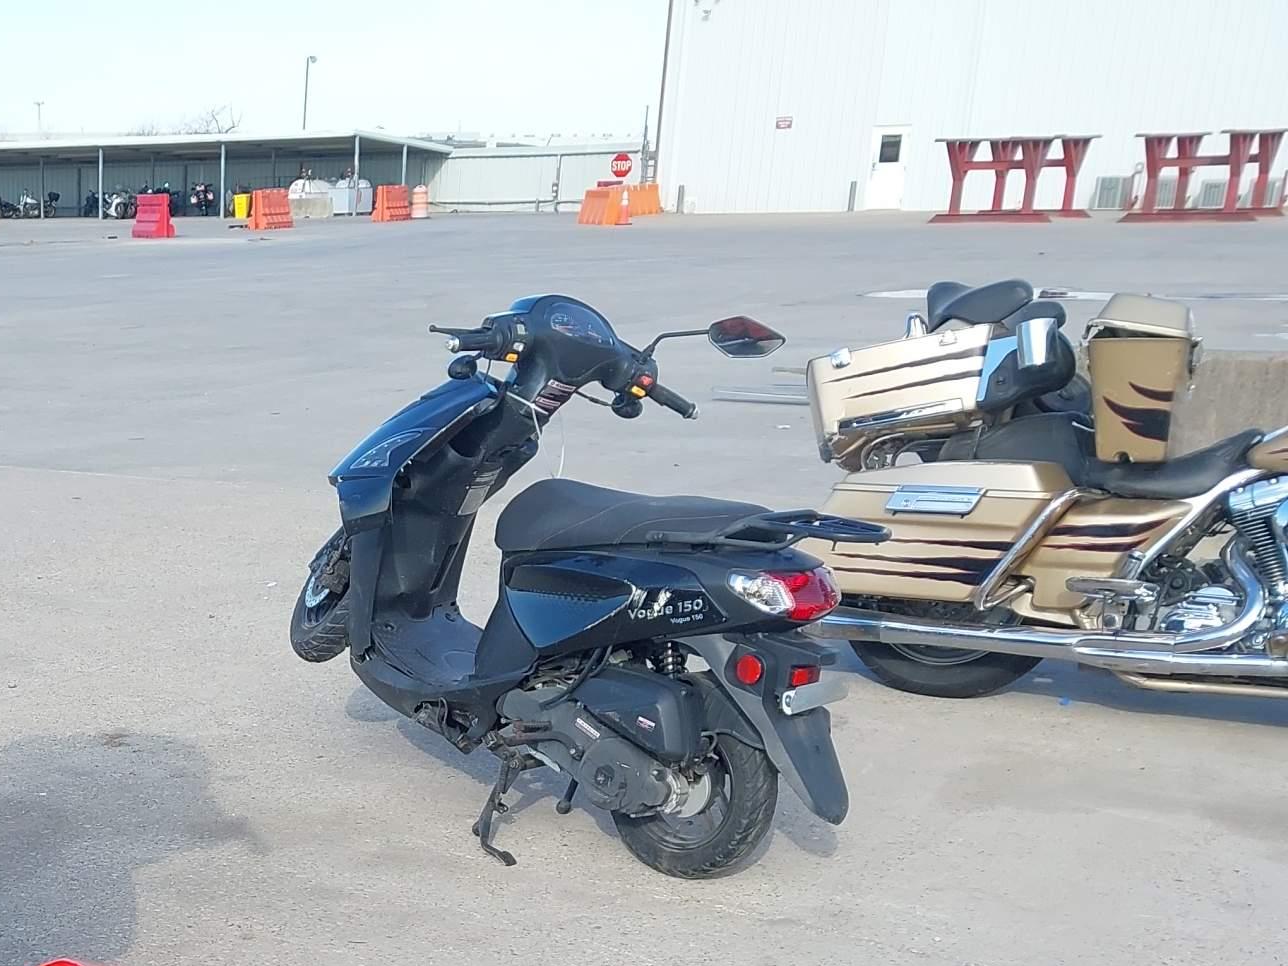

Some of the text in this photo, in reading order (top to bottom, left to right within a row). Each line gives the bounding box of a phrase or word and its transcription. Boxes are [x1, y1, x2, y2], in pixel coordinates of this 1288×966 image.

[612, 160, 632, 172] STOP
[677, 599, 703, 613] 150
[670, 613, 704, 624] Vogue 150
